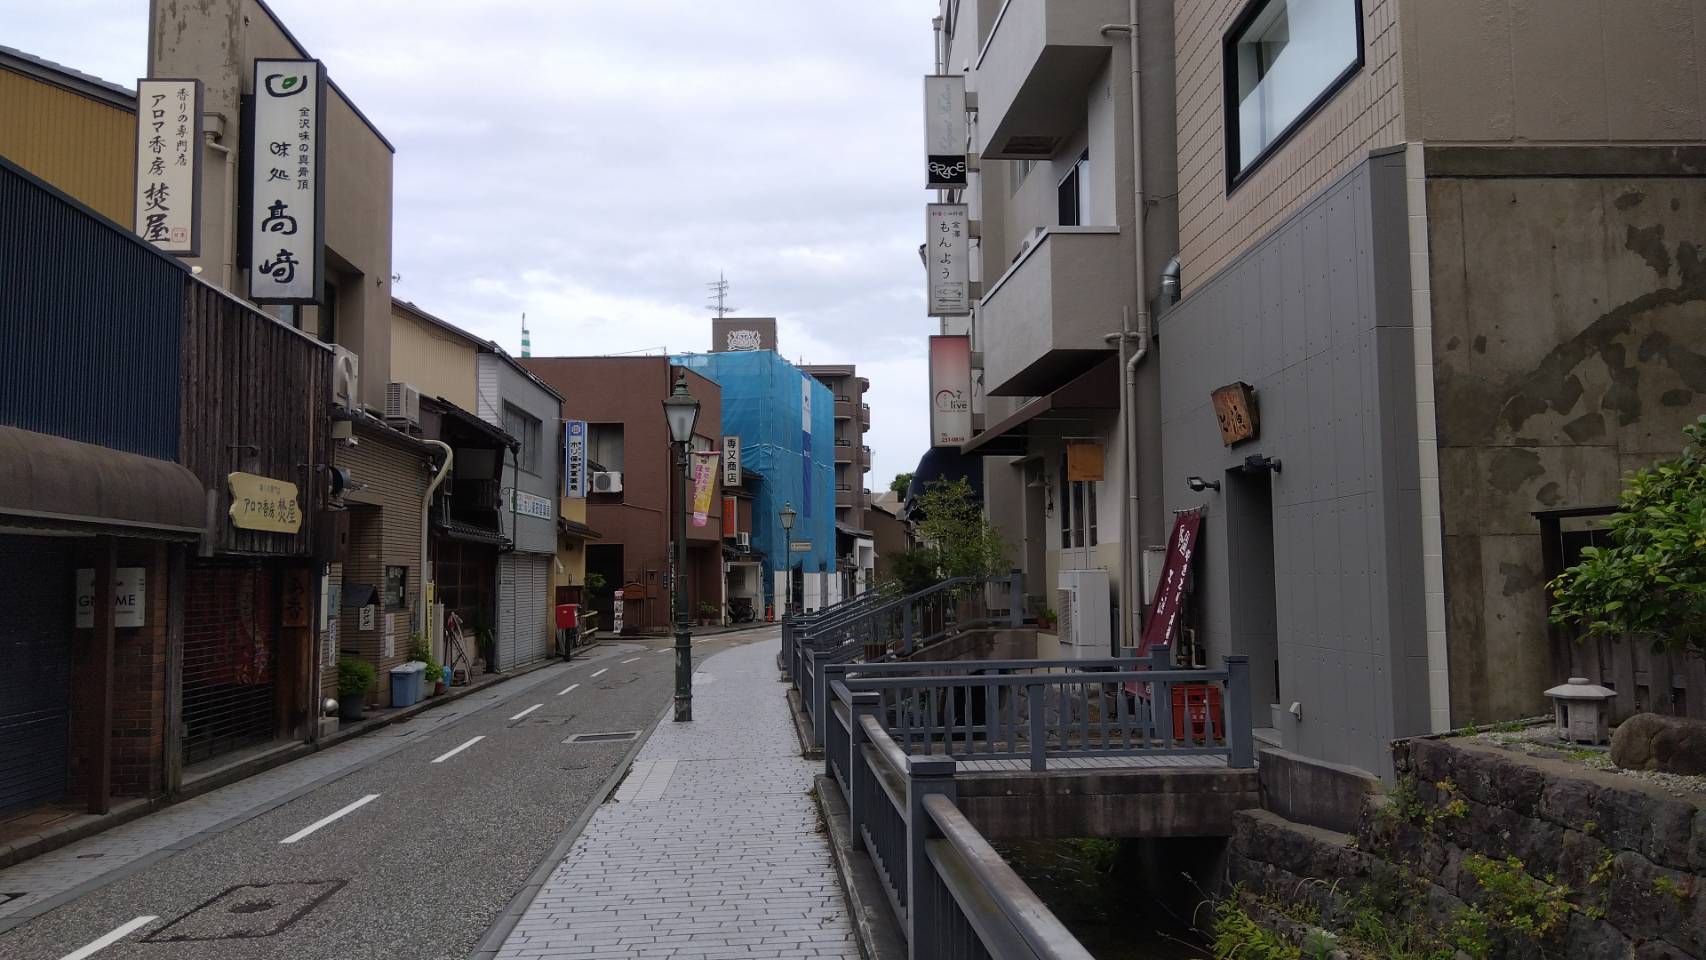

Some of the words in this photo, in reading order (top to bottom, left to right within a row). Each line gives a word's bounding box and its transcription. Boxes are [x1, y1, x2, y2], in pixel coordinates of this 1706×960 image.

[174, 88, 189, 167] 香りの専門店
[297, 107, 310, 190] 金沢味の真骨頂
[929, 162, 965, 178] GRACE
[939, 221, 952, 279] もんよう
